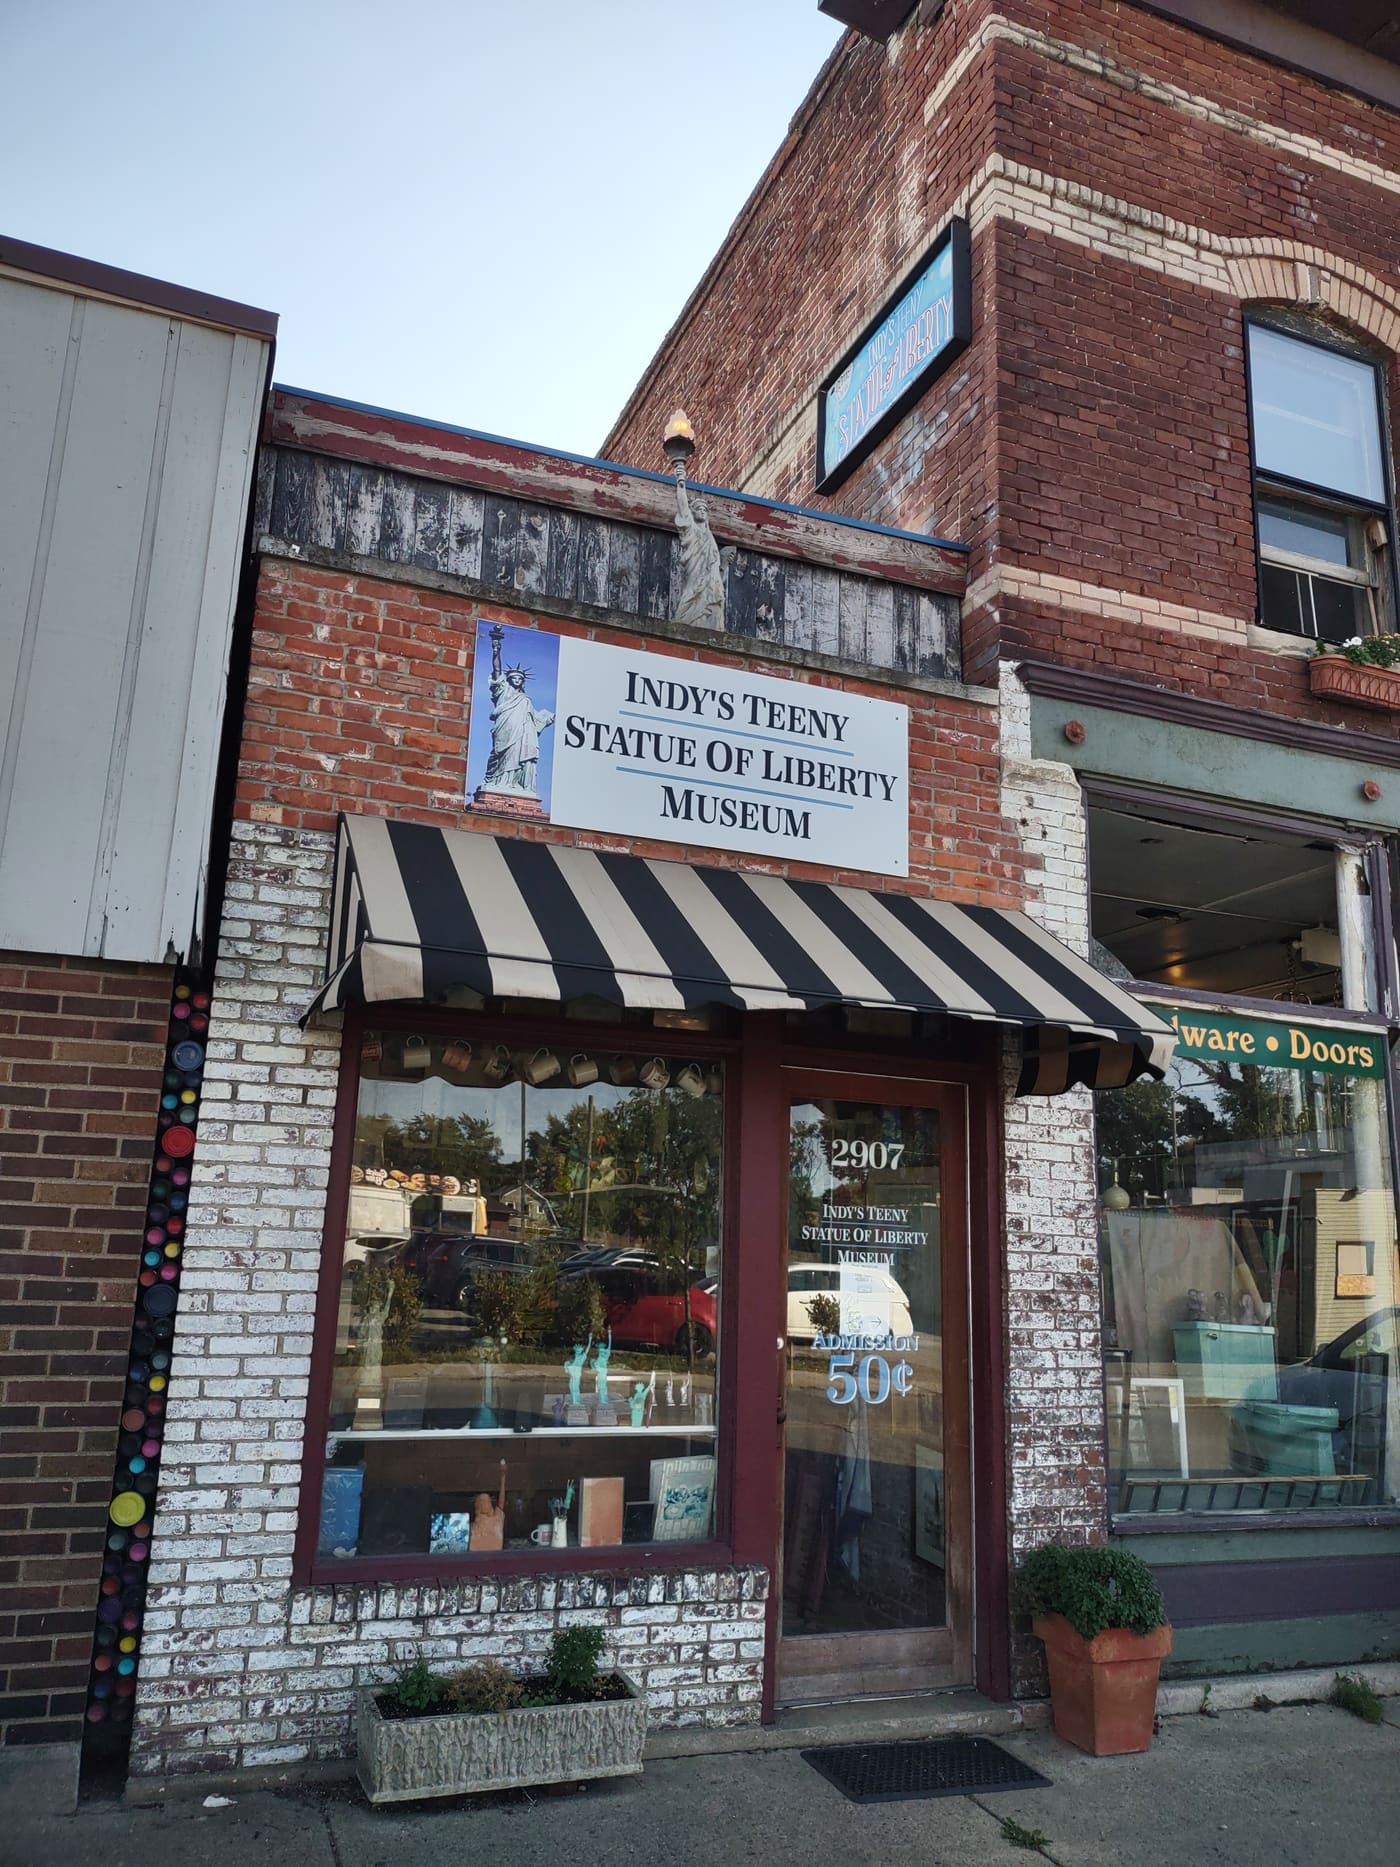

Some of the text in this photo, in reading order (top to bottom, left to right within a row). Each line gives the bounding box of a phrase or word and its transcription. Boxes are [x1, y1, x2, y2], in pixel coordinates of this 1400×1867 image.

[898, 287, 953, 383] LIBERTY
[624, 671, 850, 742] INDY'S TEENY
[564, 714, 898, 802] STATUE OF LIBERTY
[659, 785, 812, 840] MUSEUM
[1289, 1029, 1374, 1067] Doors
[831, 1139, 905, 1171] 2907
[823, 1204, 909, 1222] INDY'S TEENY
[802, 1225, 928, 1245] STATUE OF LIBERTY
[837, 1250, 895, 1266] MUSEUM
[810, 1330, 920, 1351] ADMISSION
[826, 1351, 914, 1405] 50¢
